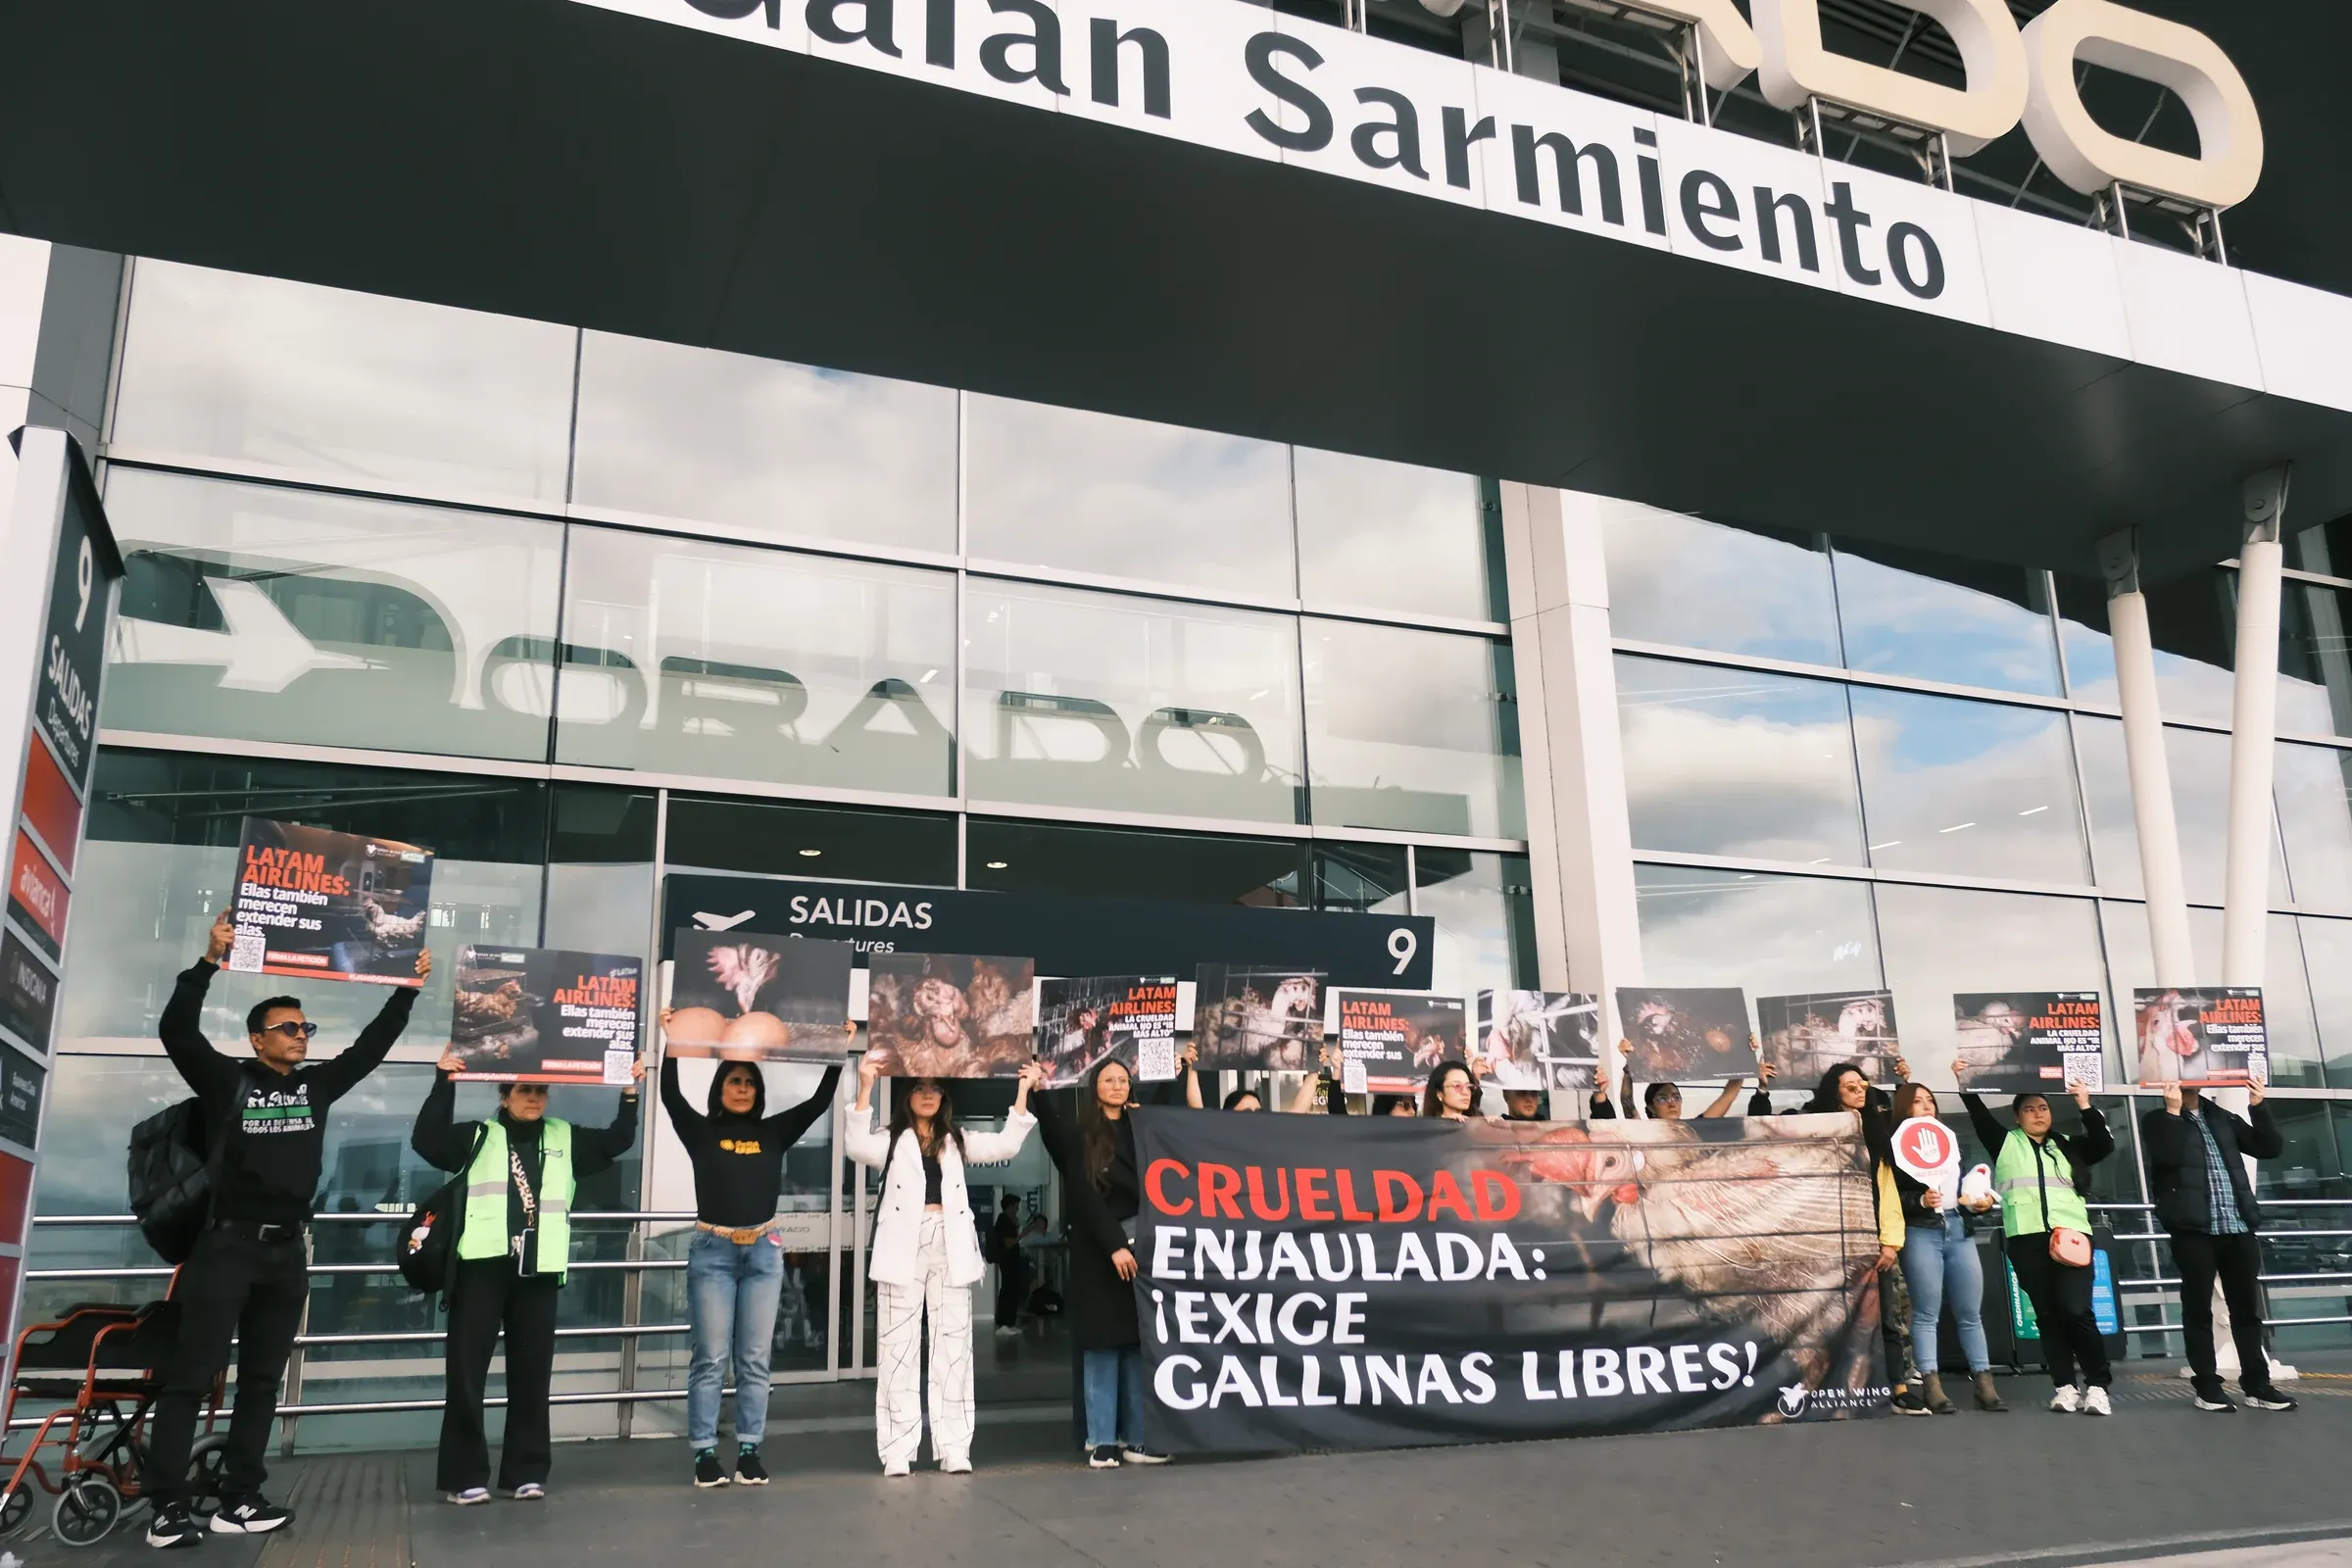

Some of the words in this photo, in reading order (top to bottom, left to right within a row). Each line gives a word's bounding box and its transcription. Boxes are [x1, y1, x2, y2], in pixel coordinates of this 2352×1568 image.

[1245, 31, 1945, 300] Sarmiento
[74, 534, 93, 634] 9
[48, 634, 92, 741] SALIDAS
[47, 696, 80, 768] Departures
[246, 845, 325, 874] LATAM
[242, 863, 351, 896] AIRLINES:
[240, 882, 271, 899] Ellas
[272, 887, 328, 906] también
[238, 898, 298, 914] merecen
[789, 895, 933, 930] SALIDAS
[236, 910, 298, 928] extender
[298, 917, 322, 930] sus
[234, 922, 266, 938] alas.
[1387, 927, 1417, 975] 9
[577, 975, 637, 994] LATAM
[553, 988, 636, 1008] AIRLINES:
[1128, 986, 1176, 1001] LATAM
[561, 1004, 588, 1017] Ellas
[588, 1007, 636, 1020] también
[1109, 1001, 1175, 1015] AIRLINES:
[1342, 1001, 1392, 1016] LATAM
[2047, 1003, 2098, 1015] LATAM
[2216, 999, 2260, 1011] LATAM
[586, 1018, 635, 1030] merecen
[1136, 1013, 1174, 1022] CRUELDAD
[1342, 1015, 1410, 1031] AIRLINES:
[2029, 1016, 2099, 1029] AIRLINES:
[2199, 1011, 2262, 1024] AIRLINES:
[563, 1027, 615, 1039] extender
[615, 1029, 635, 1041] sus
[1108, 1022, 1139, 1031] ANIMAL
[2206, 1024, 2228, 1034] Ellas
[2228, 1024, 2264, 1034] también
[1342, 1029, 1364, 1040] Ellas
[1365, 1030, 1404, 1042] también
[1343, 1040, 1384, 1051] merecen
[2210, 1043, 2250, 1052] extender
[1343, 1049, 1385, 1059] extender
[1386, 1051, 1402, 1060] sus
[1145, 1158, 1522, 1222] CRUELDAD
[1152, 1225, 1545, 1282] ENJAULADA:
[2010, 1270, 2024, 1327] ORDINARIOS
[1152, 1289, 1368, 1346] ¡EXIGE
[1153, 1351, 1496, 1410] GALLINAS
[1522, 1341, 1758, 1400] LIBRES!
[1811, 1388, 1846, 1398] OPEN
[1852, 1387, 1891, 1397] WING
